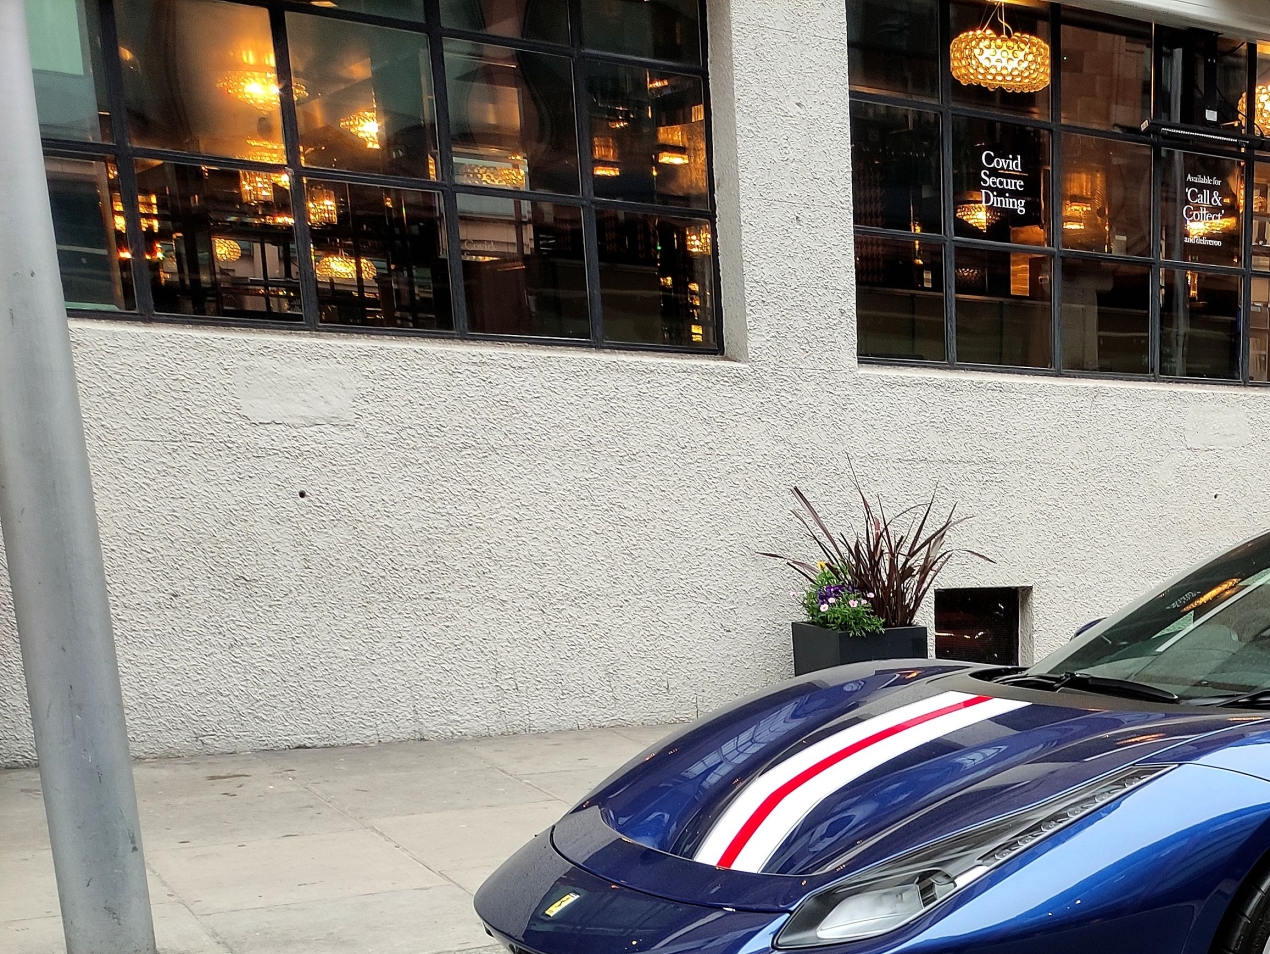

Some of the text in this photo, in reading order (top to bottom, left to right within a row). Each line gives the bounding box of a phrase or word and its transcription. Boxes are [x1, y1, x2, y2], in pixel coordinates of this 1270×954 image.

[982, 151, 1021, 171] Covid
[981, 170, 1024, 190] Secure
[1186, 174, 1222, 185] Available for
[981, 189, 1026, 215] Dining
[1211, 190, 1222, 206] &
[1184, 236, 1196, 244] and
